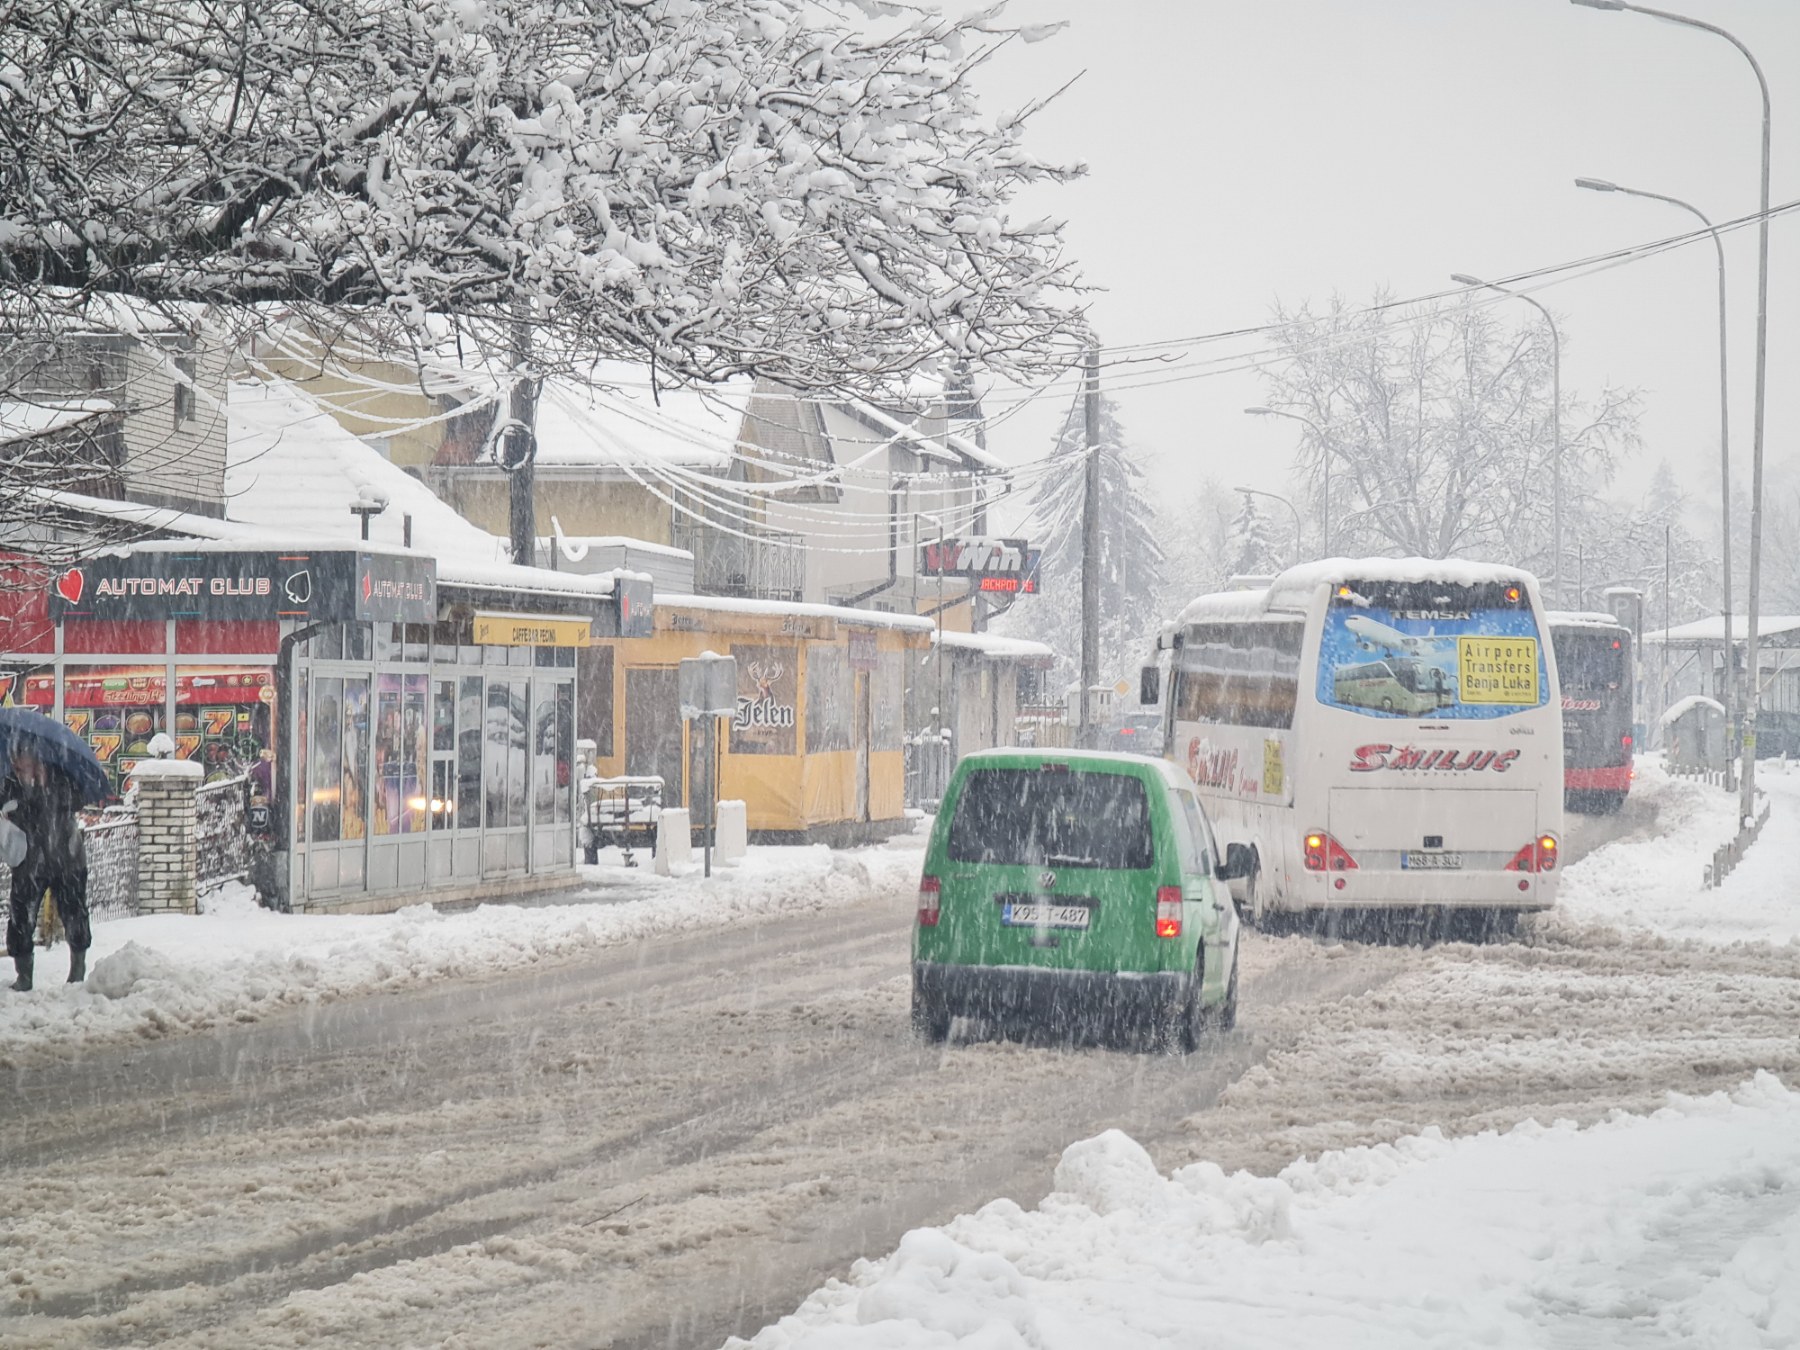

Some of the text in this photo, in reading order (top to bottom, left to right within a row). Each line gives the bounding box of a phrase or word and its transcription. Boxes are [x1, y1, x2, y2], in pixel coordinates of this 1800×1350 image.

[96, 578, 270, 595] AUTOMAT CLUB
[373, 580, 404, 598] AUTOMAT
[981, 578, 1017, 592] JACKPOT
[1390, 610, 1470, 620] TEMSA
[1465, 643, 1531, 661] Airport
[1465, 659, 1531, 674] Transfers
[1466, 674, 1531, 692] Banja Luka
[733, 696, 794, 731] Jelen
